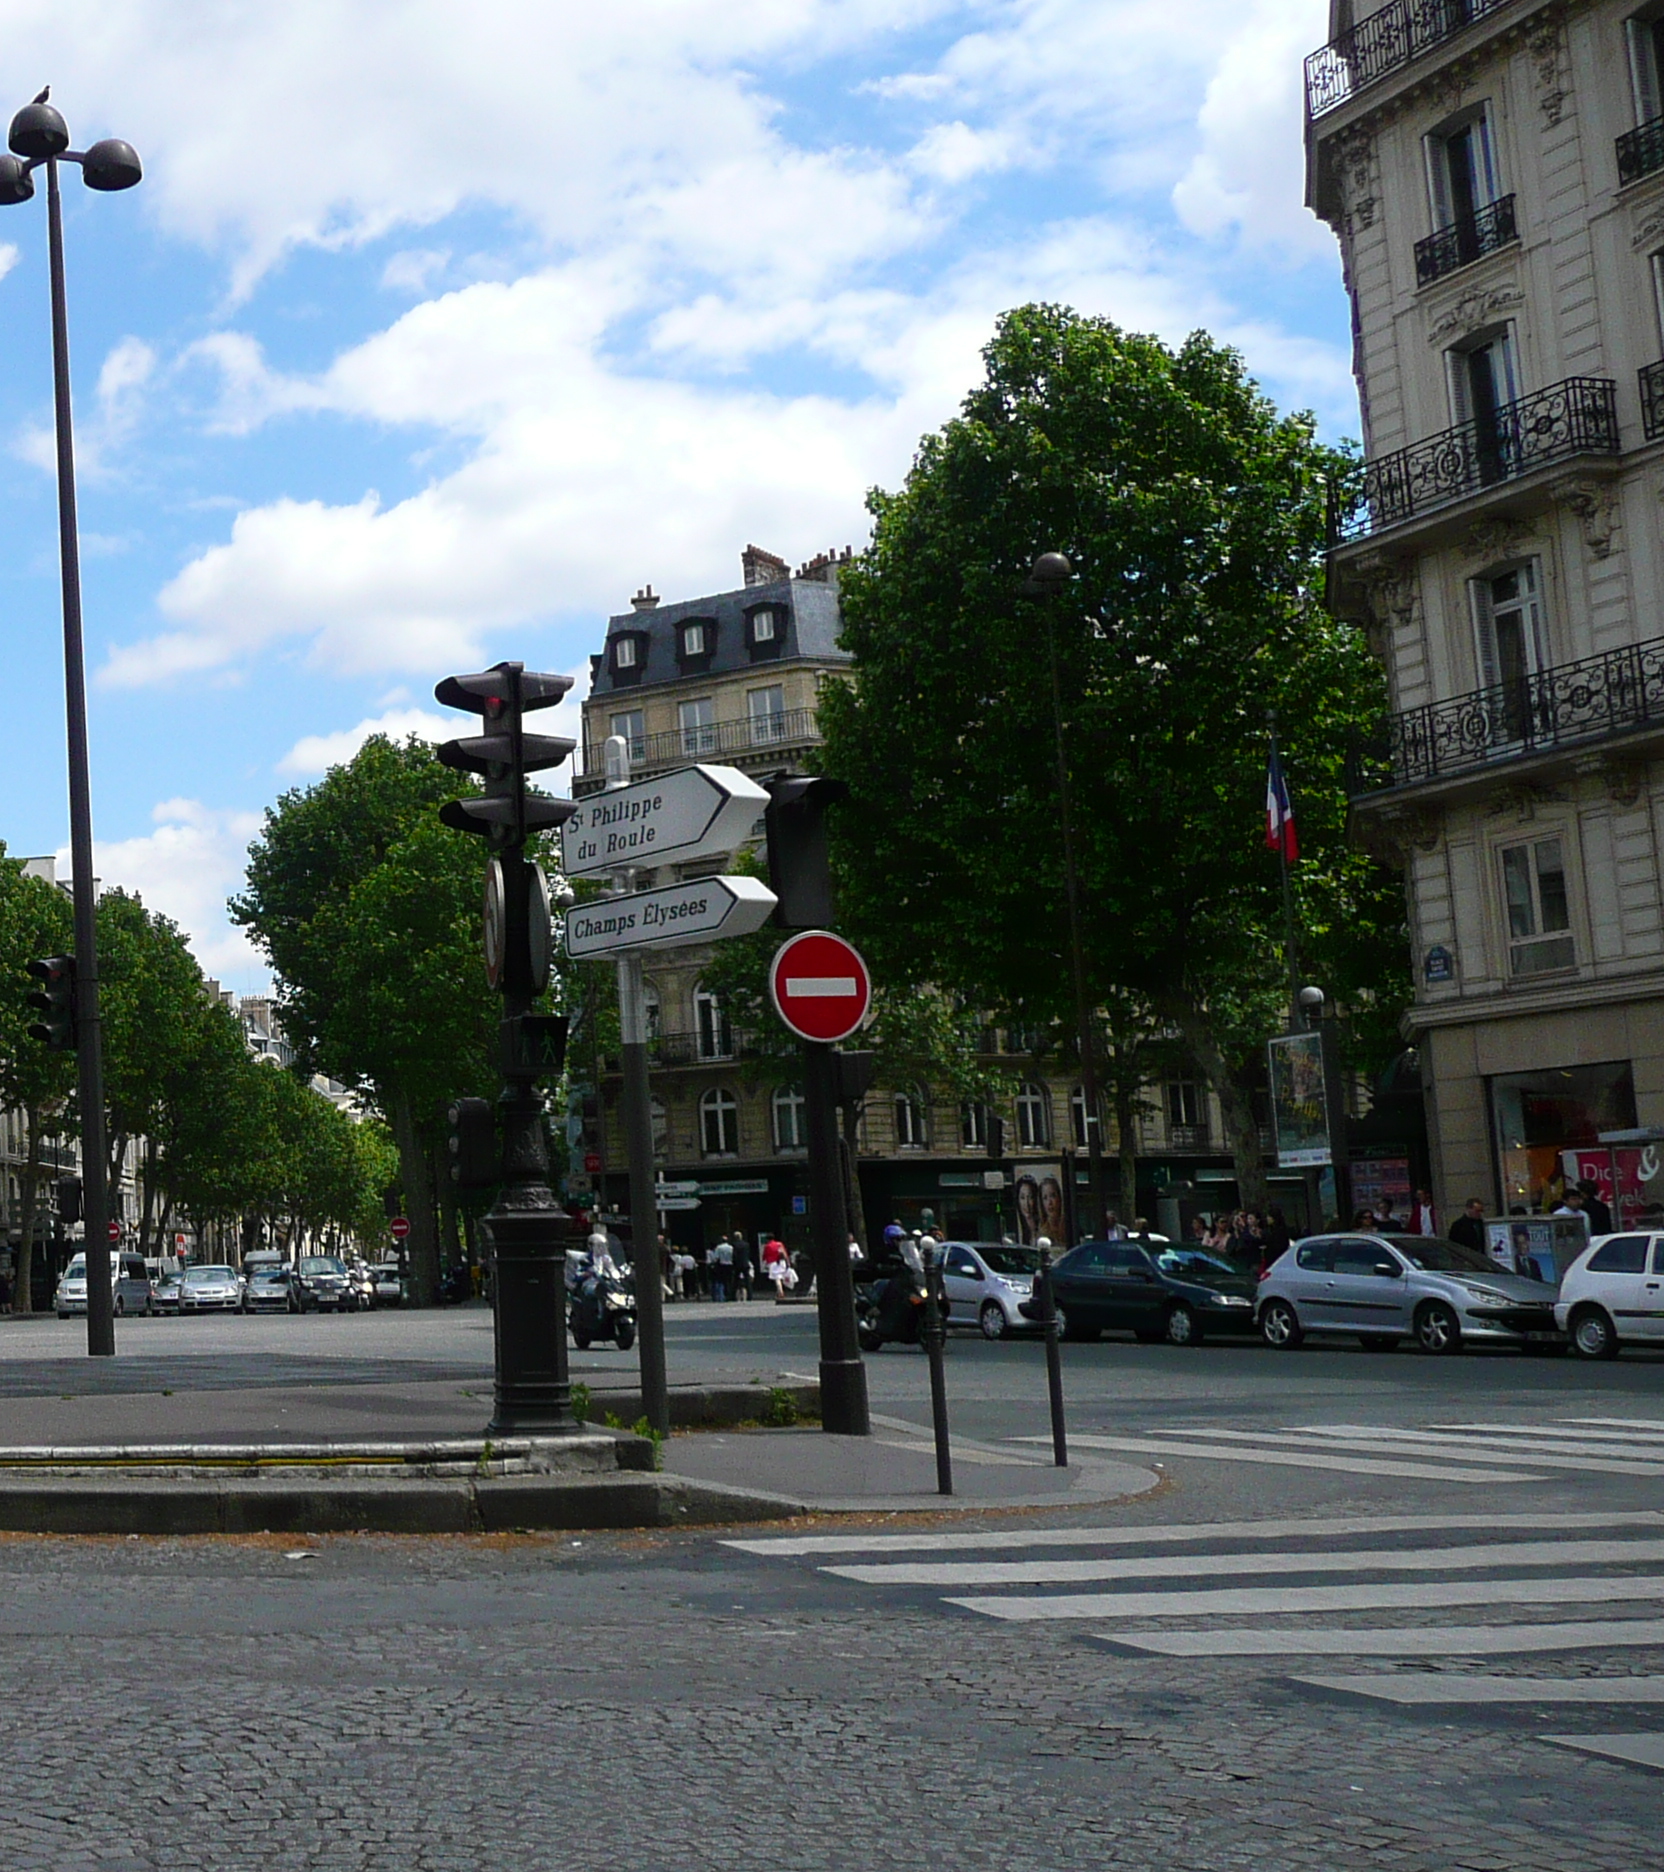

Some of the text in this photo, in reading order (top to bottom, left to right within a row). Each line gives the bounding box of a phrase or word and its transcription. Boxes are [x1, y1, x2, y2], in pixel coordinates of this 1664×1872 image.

[568, 795, 663, 834] St Philippe
[577, 825, 656, 860] du Roule
[574, 898, 708, 939] Champs Élysées
